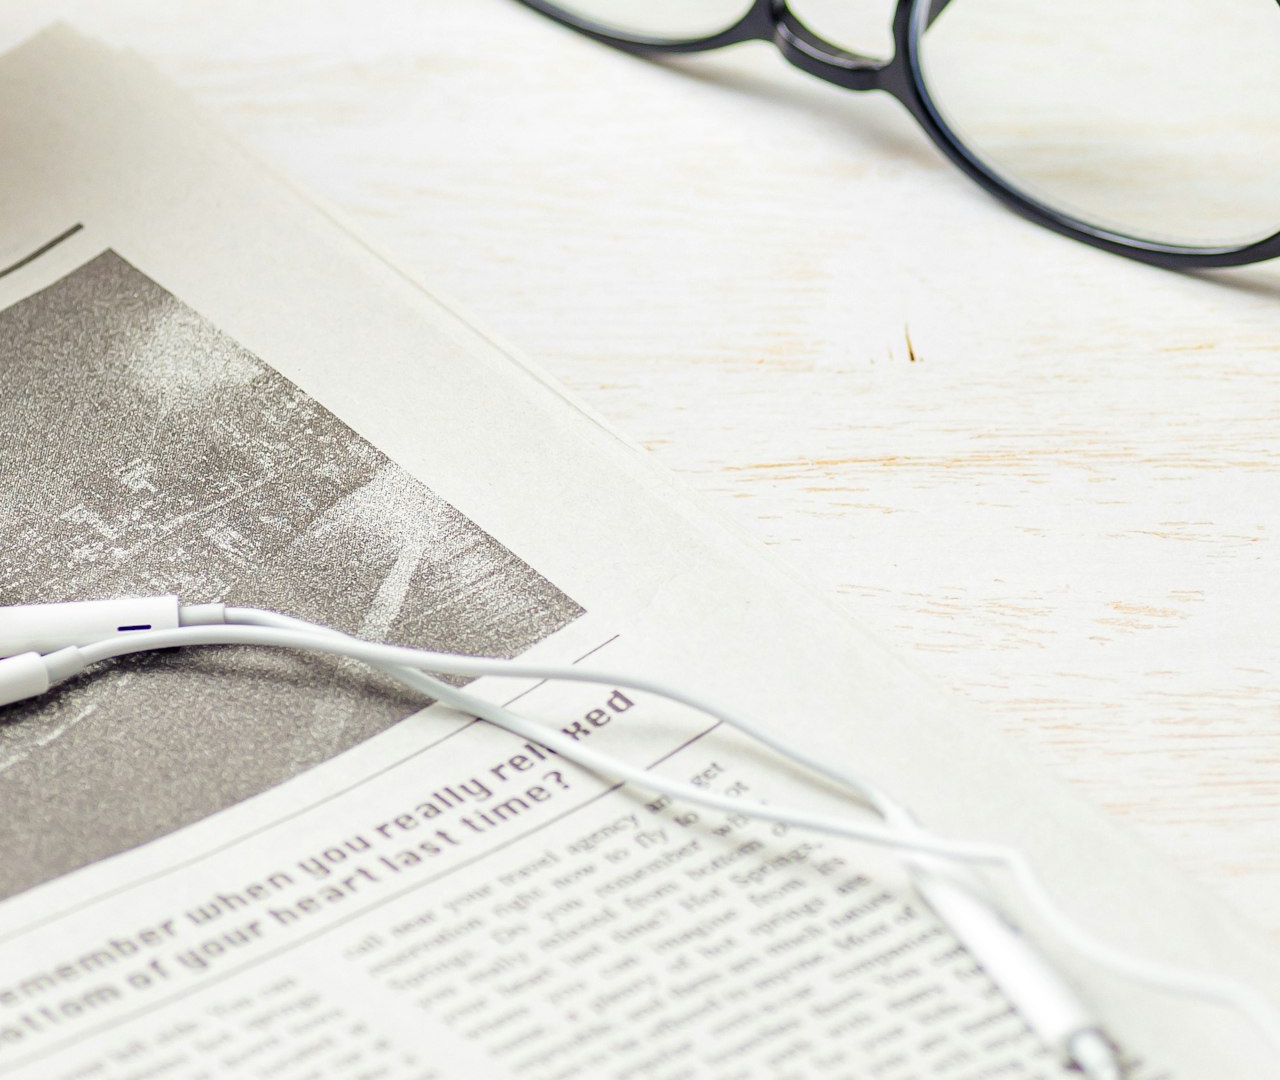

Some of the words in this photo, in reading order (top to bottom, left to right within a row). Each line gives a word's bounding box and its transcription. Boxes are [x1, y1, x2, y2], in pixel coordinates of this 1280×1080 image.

[128, 958, 170, 989] of
[176, 920, 263, 970] your
[268, 868, 380, 927] heart
[379, 829, 461, 873] last
[461, 770, 571, 832] time?
[185, 872, 295, 926] when
[298, 835, 373, 881] you
[376, 778, 494, 840] really
[490, 689, 635, 782] relxed
[567, 814, 639, 855] agency
[690, 761, 725, 788] get
